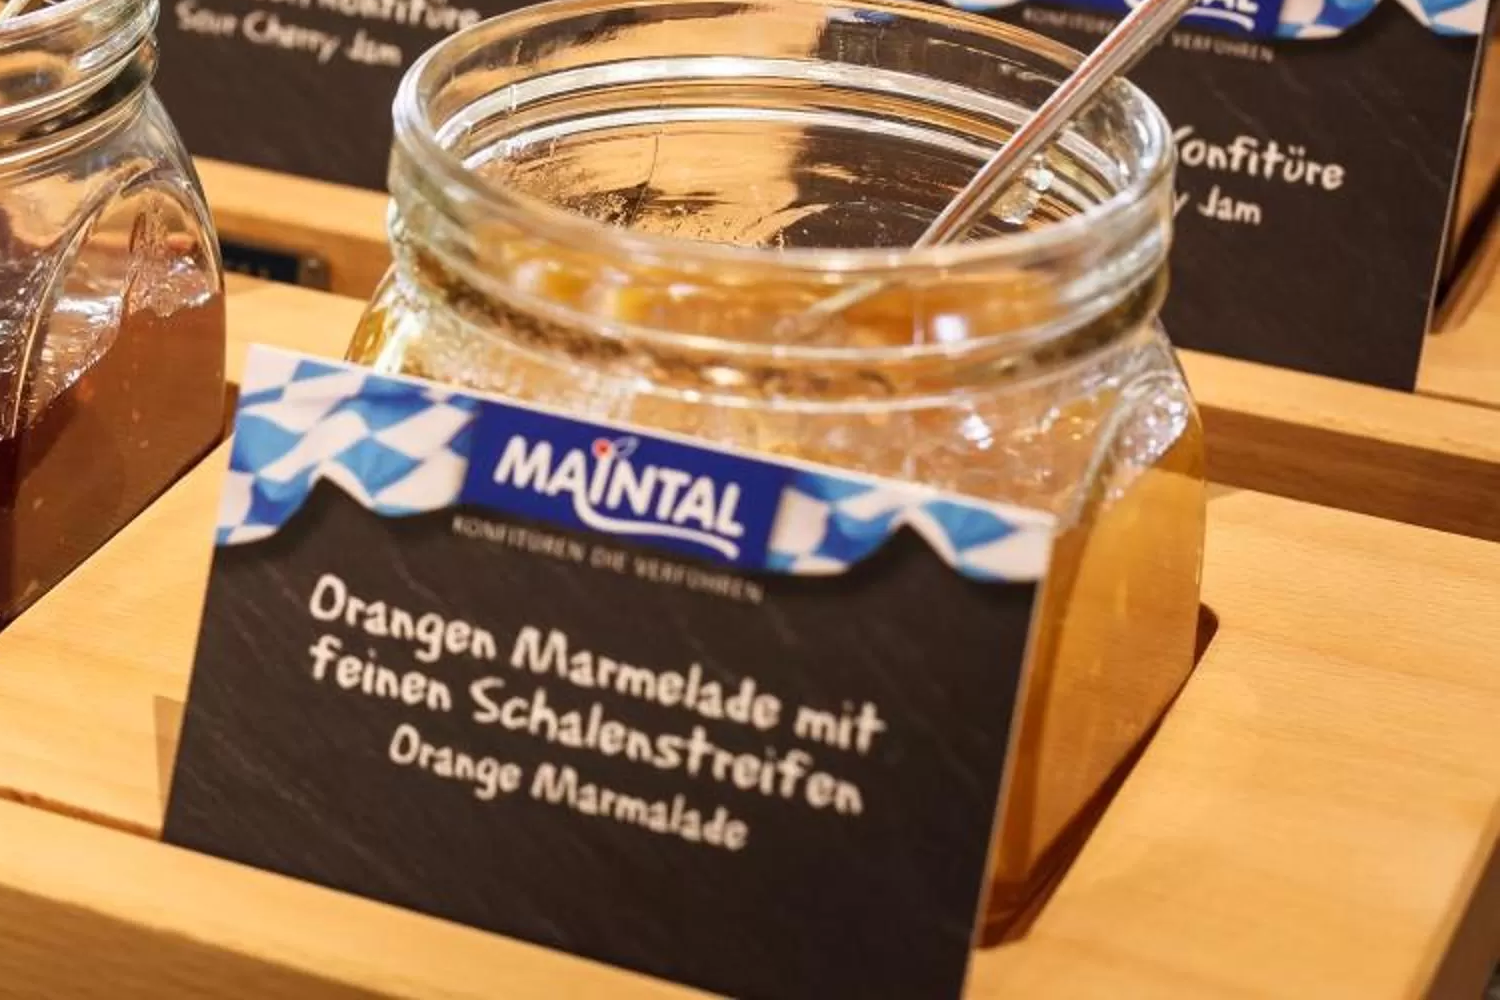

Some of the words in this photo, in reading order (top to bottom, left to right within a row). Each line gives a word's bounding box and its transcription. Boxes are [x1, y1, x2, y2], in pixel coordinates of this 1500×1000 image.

[1197, 184, 1262, 225] Jam
[493, 435, 744, 560] MAINTAL
[309, 572, 498, 663] Orangen
[511, 627, 781, 733] Marmelade
[794, 701, 887, 757] mit
[309, 637, 453, 714] feinen
[471, 677, 864, 816] Schalenstreifen
[389, 724, 521, 799] Orange
[531, 767, 749, 851] Marmalade
